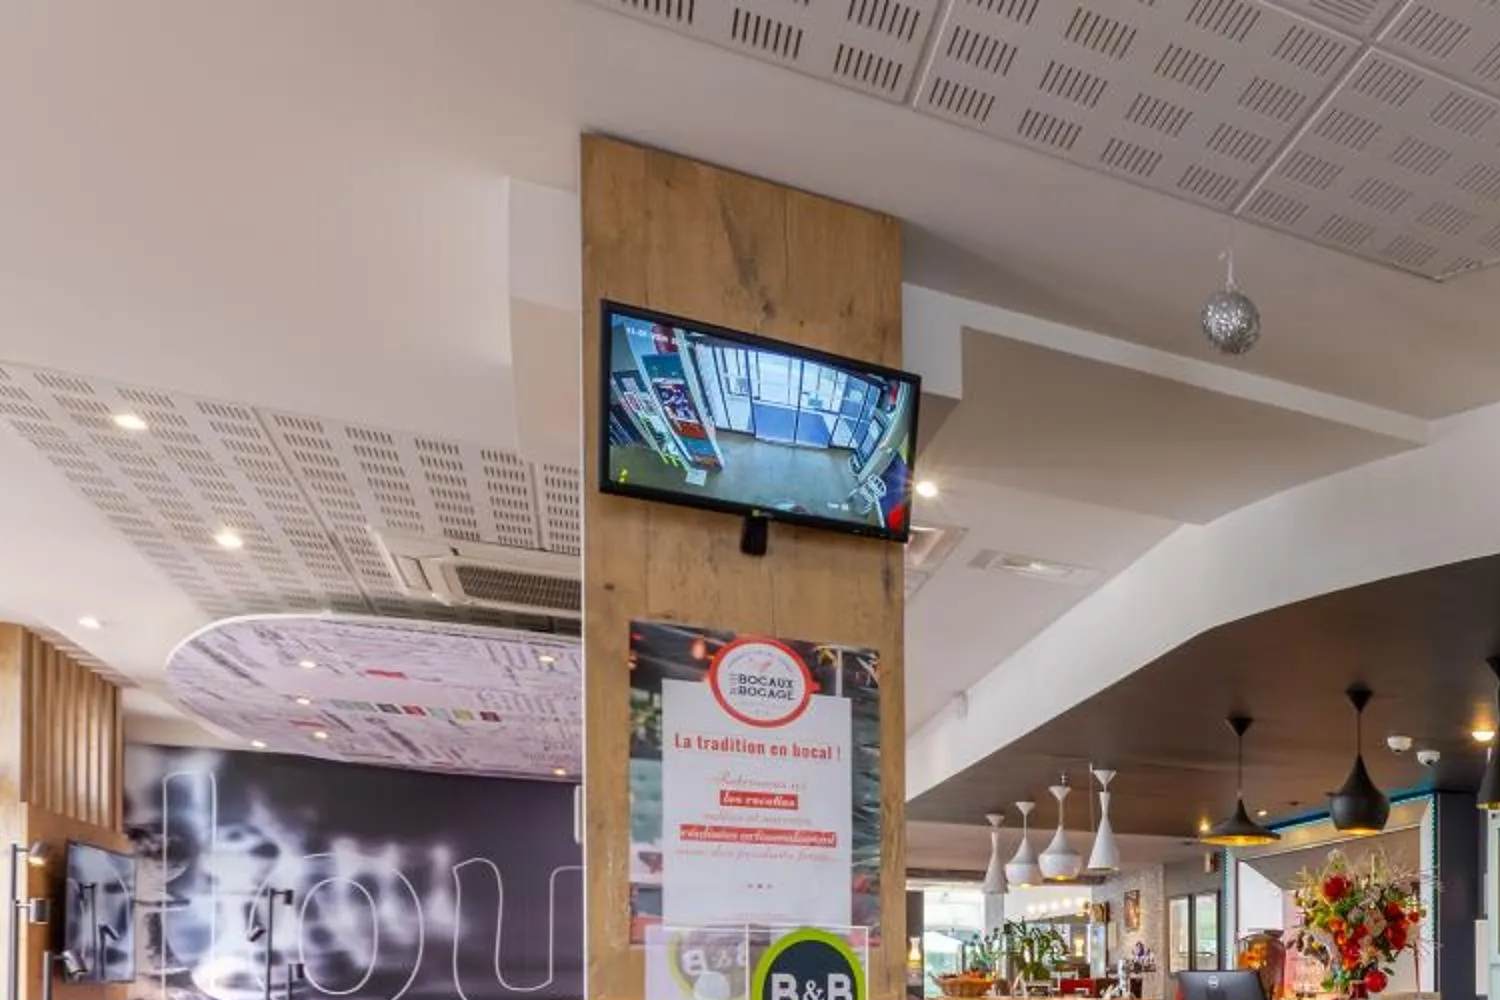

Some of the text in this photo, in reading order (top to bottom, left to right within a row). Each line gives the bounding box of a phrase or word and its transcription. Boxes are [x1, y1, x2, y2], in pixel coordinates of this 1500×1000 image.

[738, 674, 794, 689] BOCAUX
[674, 733, 692, 749] La
[697, 734, 766, 756] tradition
[770, 744, 788, 758] en
[792, 743, 832, 761] bocal
